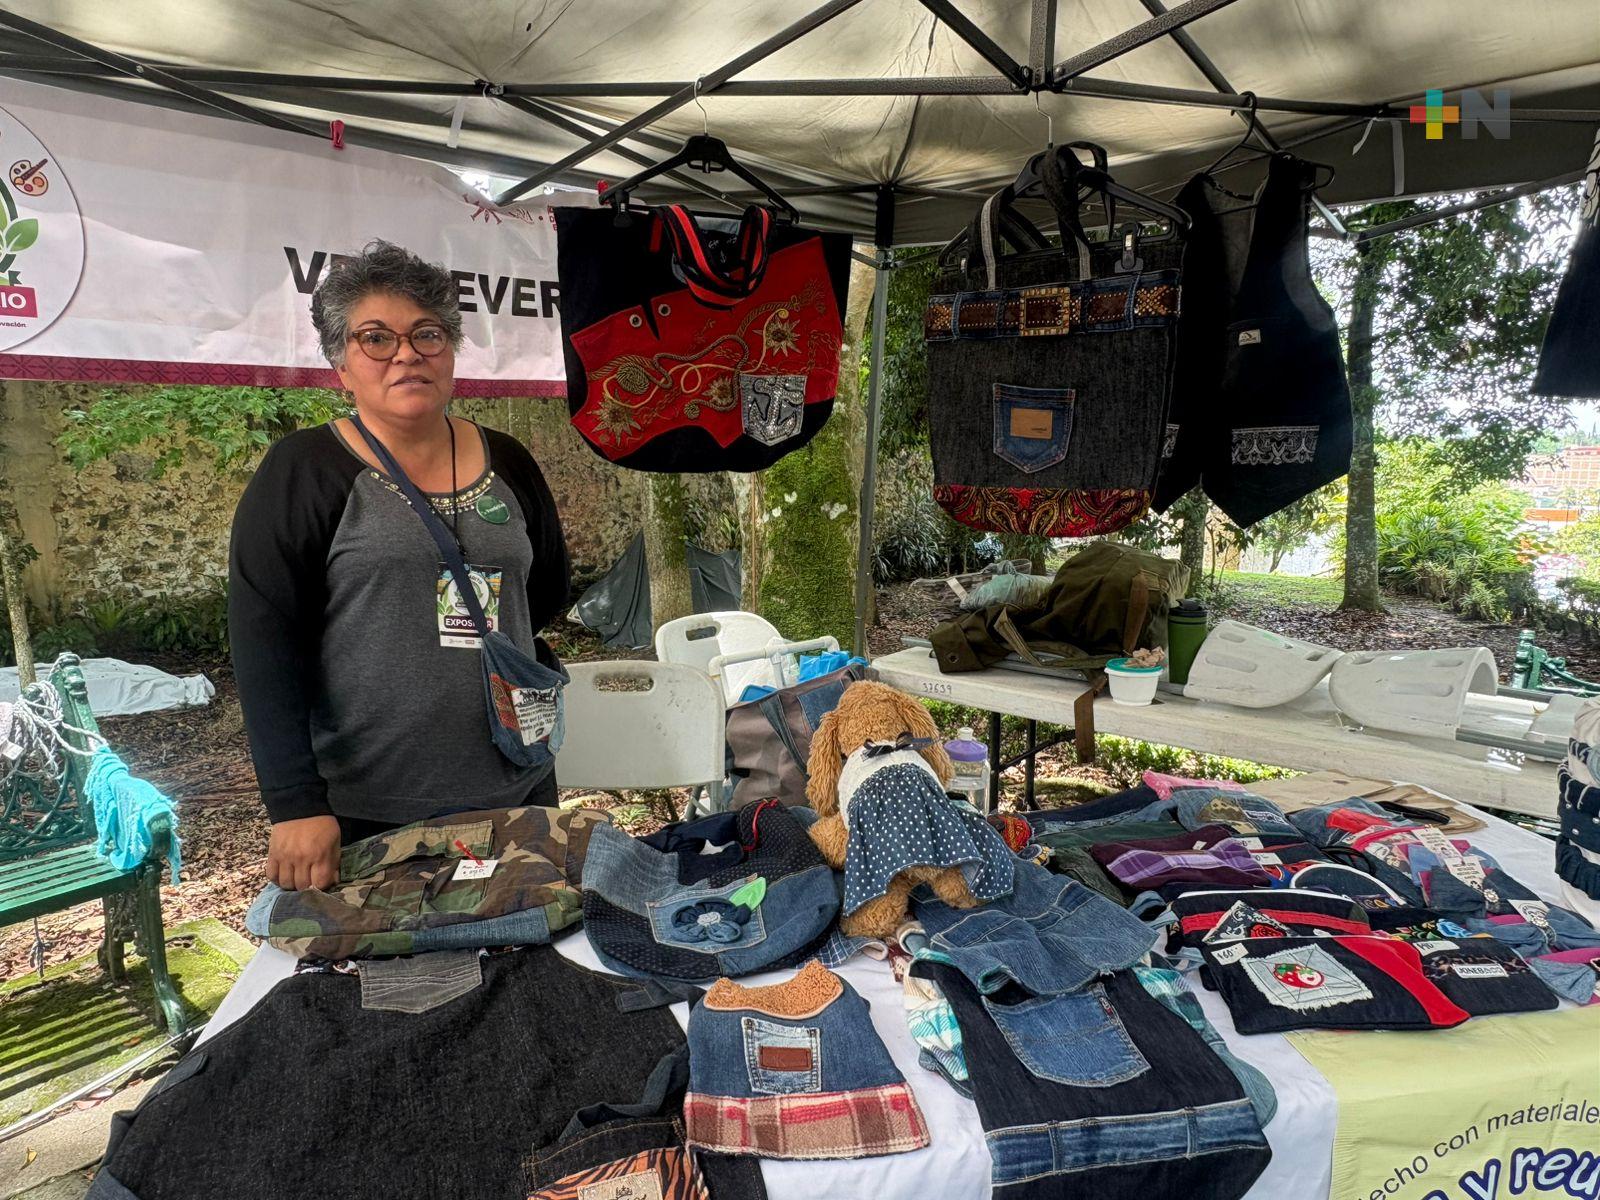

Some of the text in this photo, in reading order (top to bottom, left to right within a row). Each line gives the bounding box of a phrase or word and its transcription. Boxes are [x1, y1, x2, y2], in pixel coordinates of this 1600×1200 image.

[0, 292, 27, 309] IO
[445, 618, 493, 629] EXPOSR
[1358, 1099, 1600, 1200] echo con materiale
